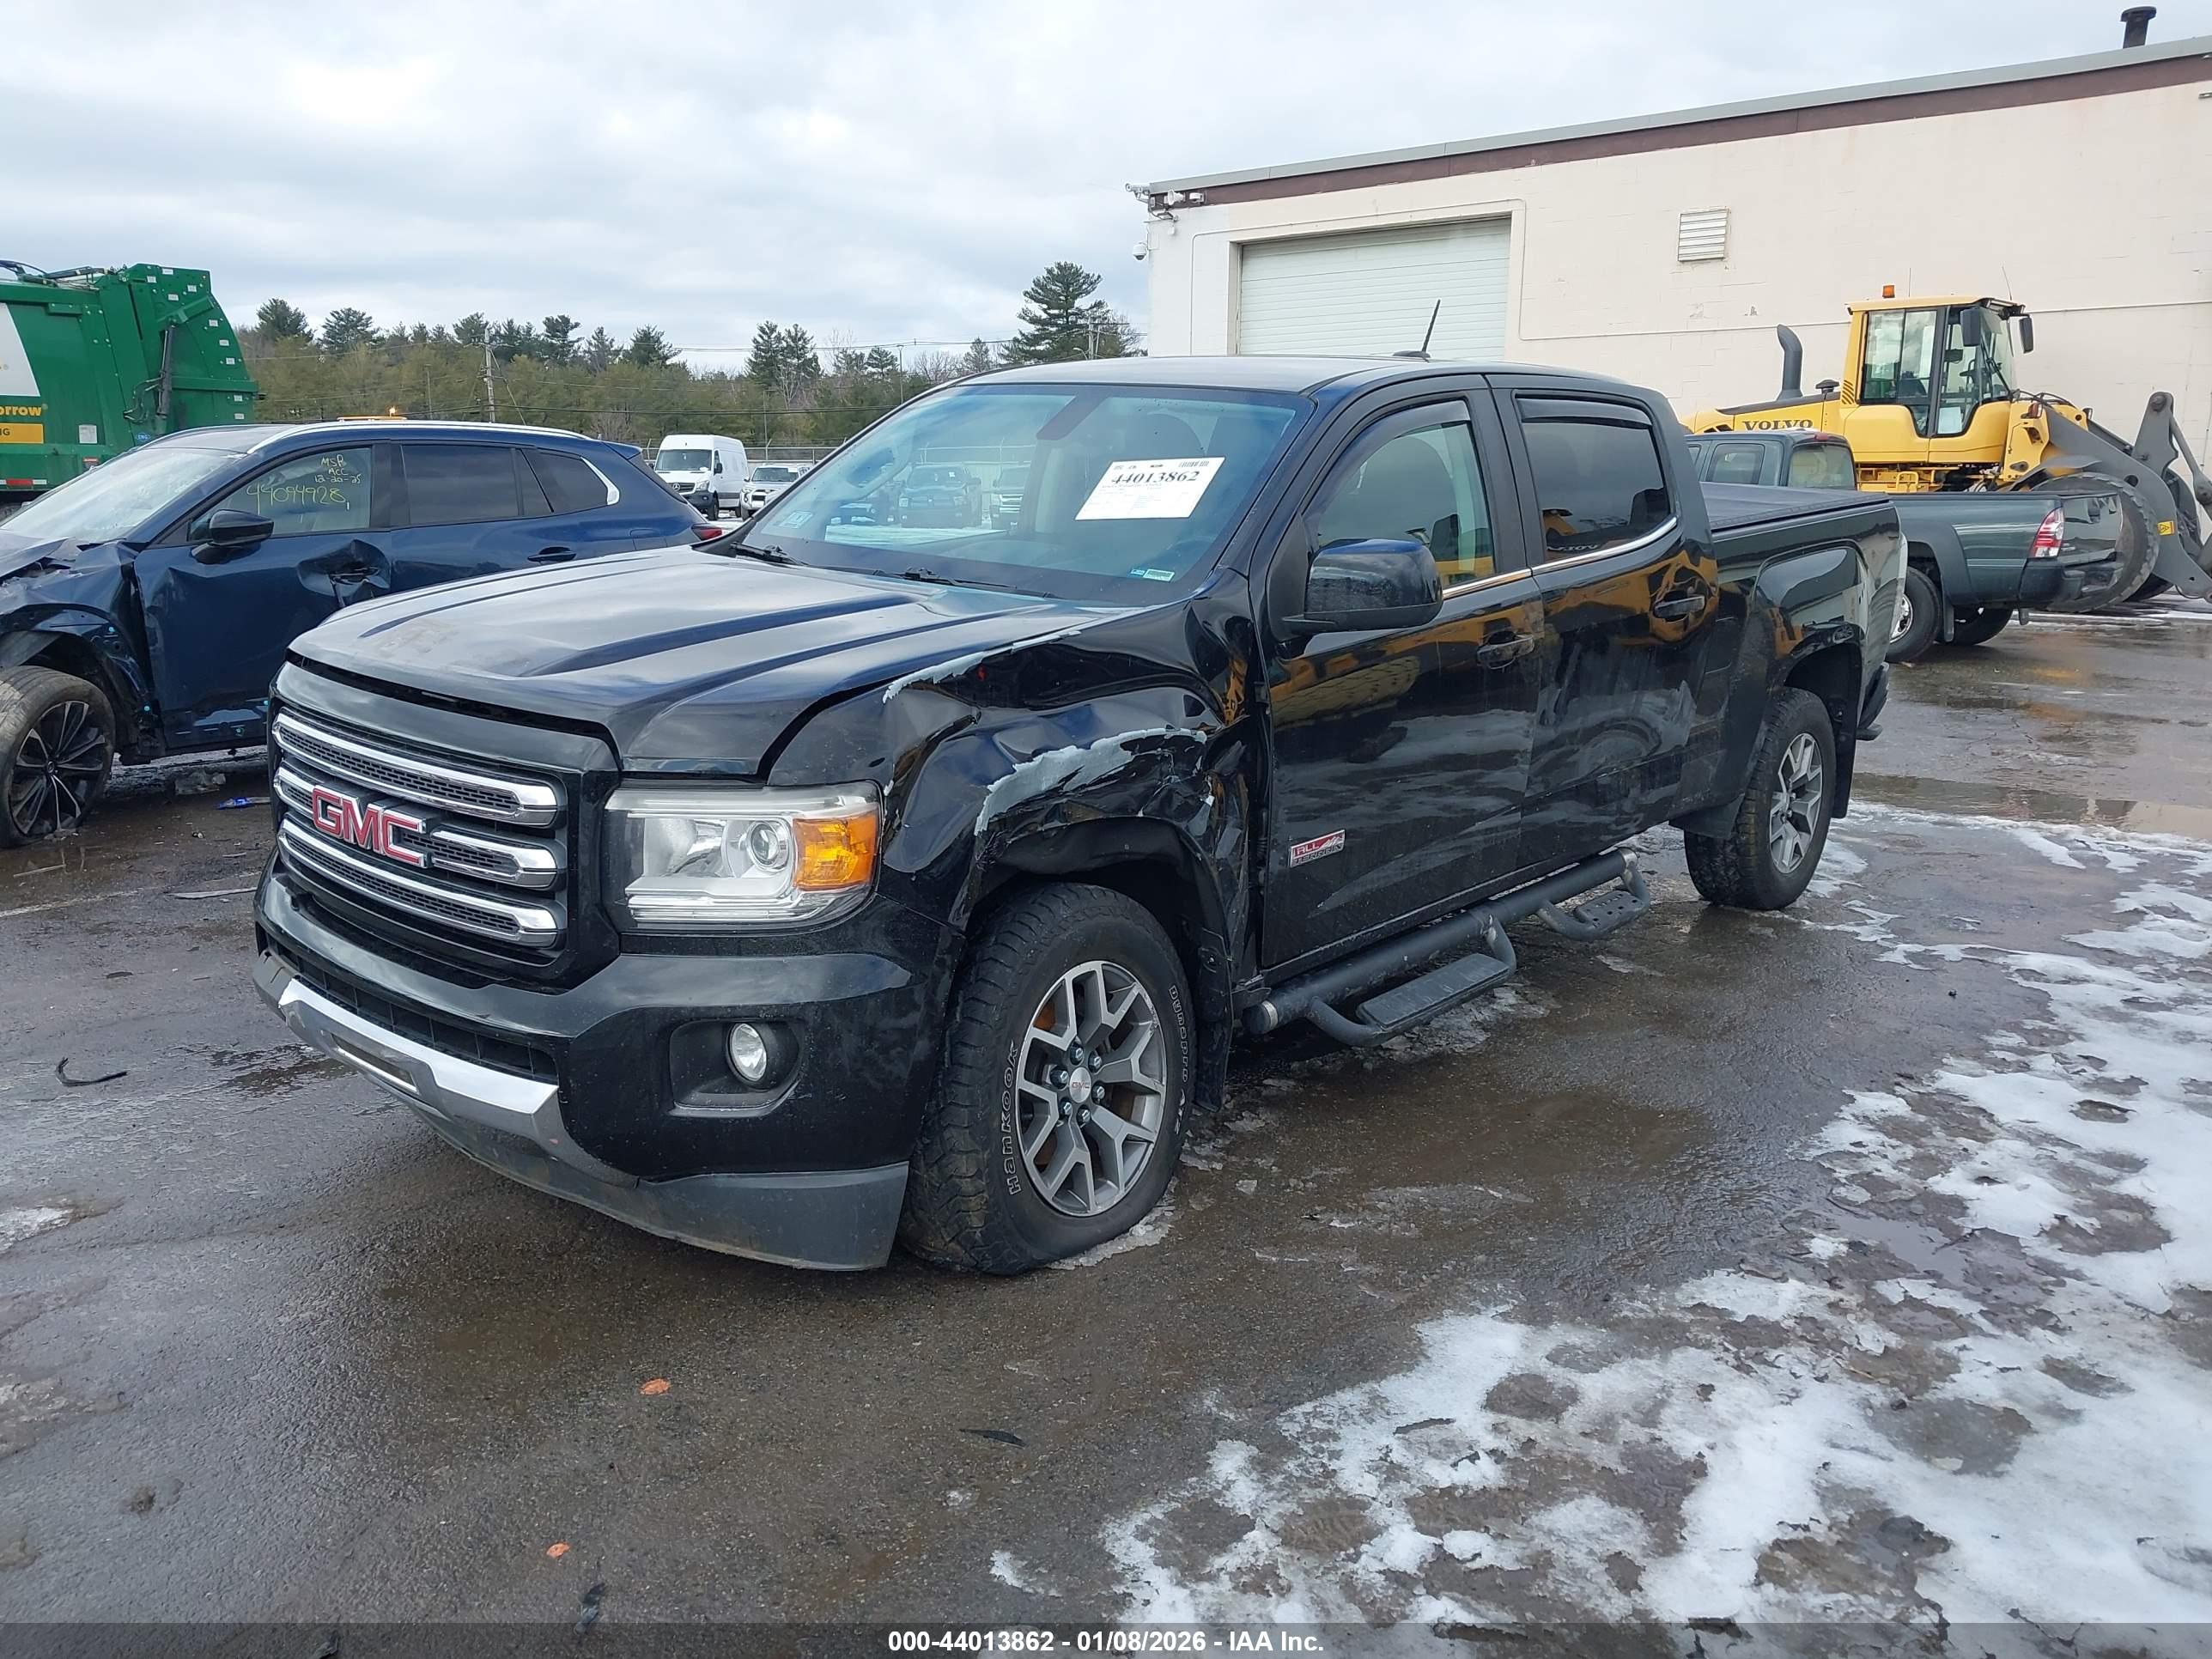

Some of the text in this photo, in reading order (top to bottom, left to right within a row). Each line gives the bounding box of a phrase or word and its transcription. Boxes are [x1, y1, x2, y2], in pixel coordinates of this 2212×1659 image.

[1742, 419, 1814, 431] VOLVO
[320, 453, 345, 468] MSP
[1112, 470, 1200, 484] 44013862
[312, 784, 428, 869] GMC
